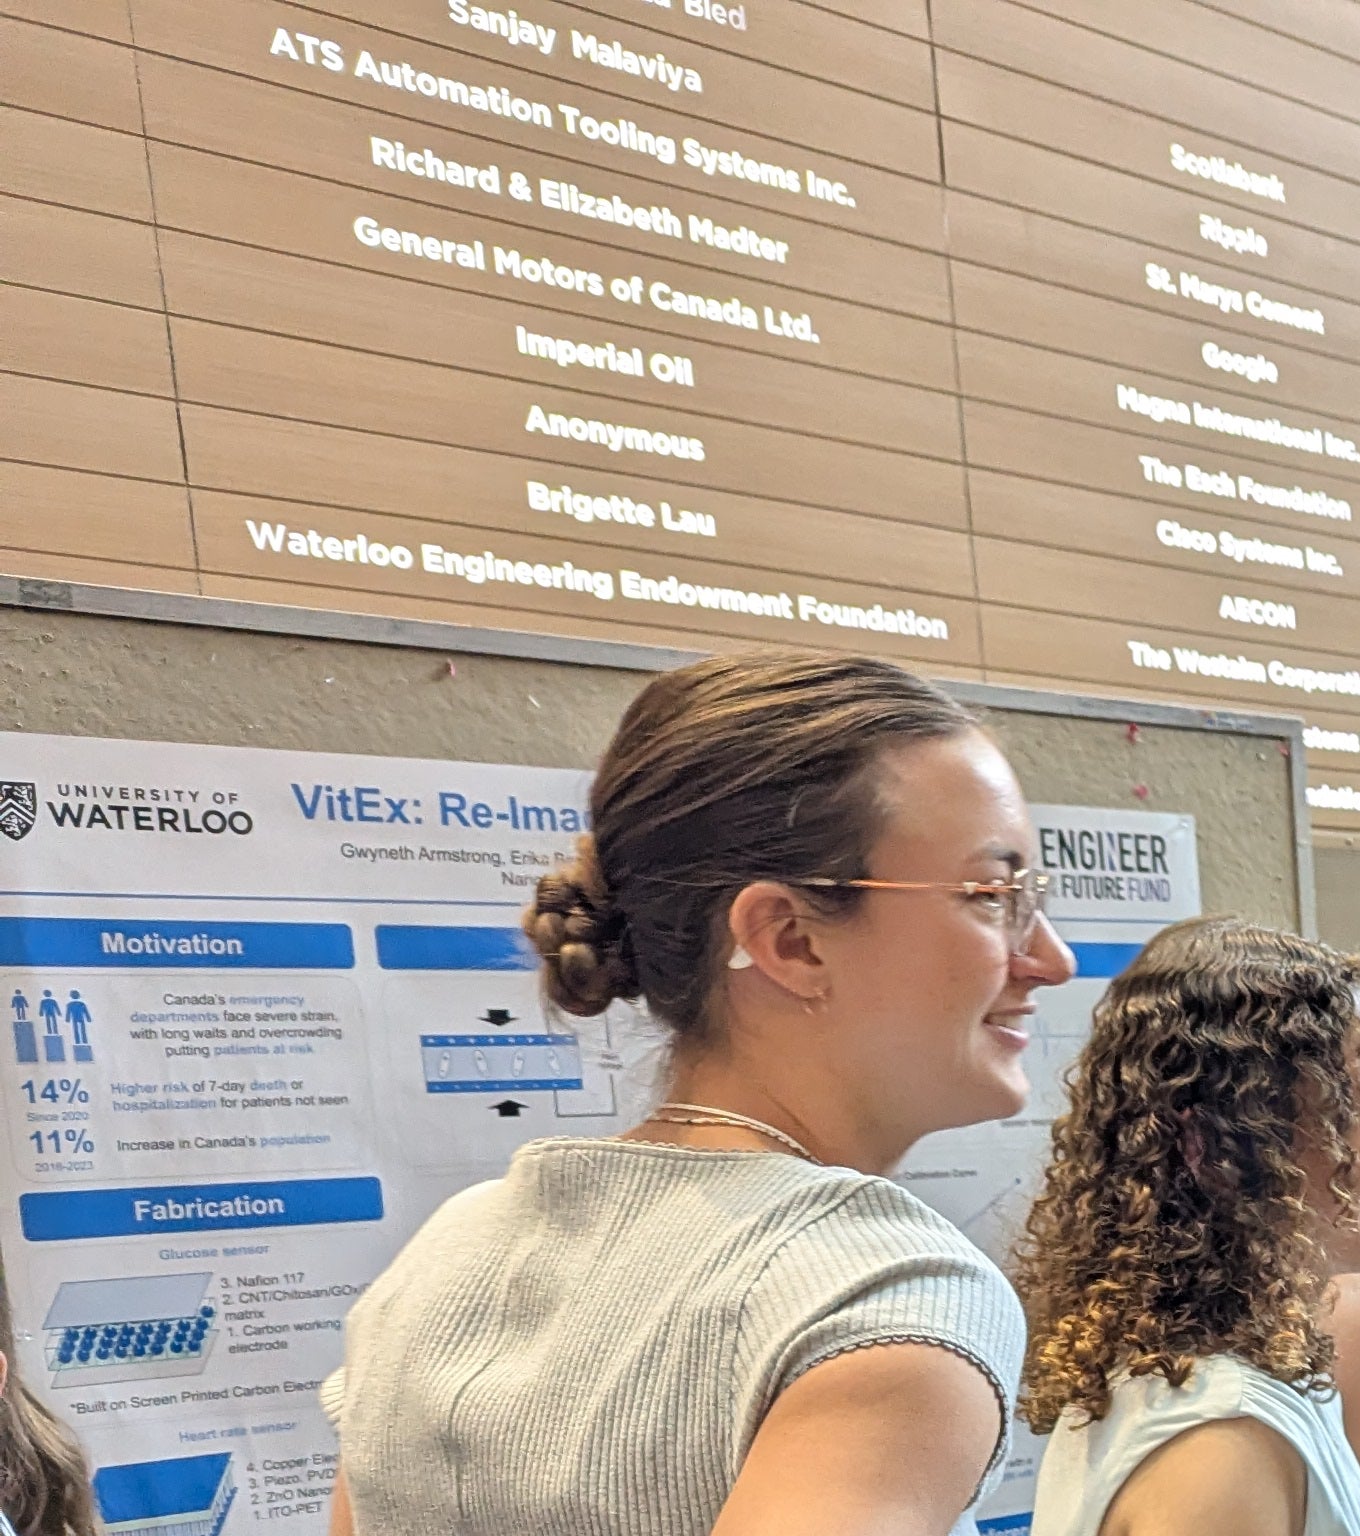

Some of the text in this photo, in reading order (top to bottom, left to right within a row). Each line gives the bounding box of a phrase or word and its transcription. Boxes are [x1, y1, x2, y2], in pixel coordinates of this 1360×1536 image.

[448, 0, 702, 92] Sanjay Malaviya
[270, 28, 856, 208] ATS Automation Tooling Systems Inc.
[371, 137, 500, 194] Richard
[508, 172, 532, 202] &
[540, 179, 682, 238] Elizabeth
[354, 216, 820, 343] General Motors of Canada Ltd.
[516, 325, 694, 386] Imperial Oil
[525, 405, 705, 461] Anonymous
[1139, 455, 1182, 487] The
[527, 481, 716, 537] Brigette Lau
[246, 520, 948, 639] Waterloo Engineering Endowment Foundation
[1127, 641, 1172, 670] The
[57, 784, 238, 805] UNIVERSITY OF
[291, 783, 422, 825] VitEx:
[46, 801, 254, 835] WATERLOO
[340, 843, 415, 862] Gwyneth
[1039, 827, 1169, 875] ENGINEER
[1060, 874, 1172, 902] FUTURE FUND
[101, 932, 244, 955] Motivation
[163, 993, 304, 1008] Canada's emergency
[129, 1011, 219, 1023] departments
[223, 1010, 250, 1022] face
[255, 1012, 297, 1022] severe
[130, 1026, 342, 1042] with long waits and overcrowding
[165, 1045, 210, 1058] putting
[213, 1044, 269, 1057] patients
[21, 1078, 89, 1104] 14%
[110, 1082, 157, 1097] Higher
[162, 1081, 190, 1093] risk
[192, 1080, 206, 1093] of
[209, 1080, 245, 1095] 7-day
[291, 1079, 304, 1090] or
[112, 1095, 349, 1113] hospitalization for patients not seen
[30, 1129, 95, 1154] 11%
[117, 1139, 175, 1152] Increase
[179, 1138, 191, 1150] in
[194, 1135, 257, 1150] Canada's
[133, 1195, 285, 1222] Fabrication
[159, 1244, 270, 1261] Glucose sensor
[220, 1277, 232, 1289] 3.
[283, 1272, 305, 1284] 117
[222, 1294, 235, 1306] 2.
[224, 1309, 265, 1322] matrix
[242, 1323, 291, 1337] Carbon
[293, 1319, 341, 1332] working
[228, 1339, 288, 1354] electrode
[110, 1400, 127, 1411] on
[130, 1394, 177, 1408] Screen
[181, 1388, 229, 1403] Printed
[232, 1384, 280, 1398] Carbon
[282, 1380, 323, 1393] Electr
[178, 1429, 216, 1443] Heart
[251, 1422, 297, 1436] sensor
